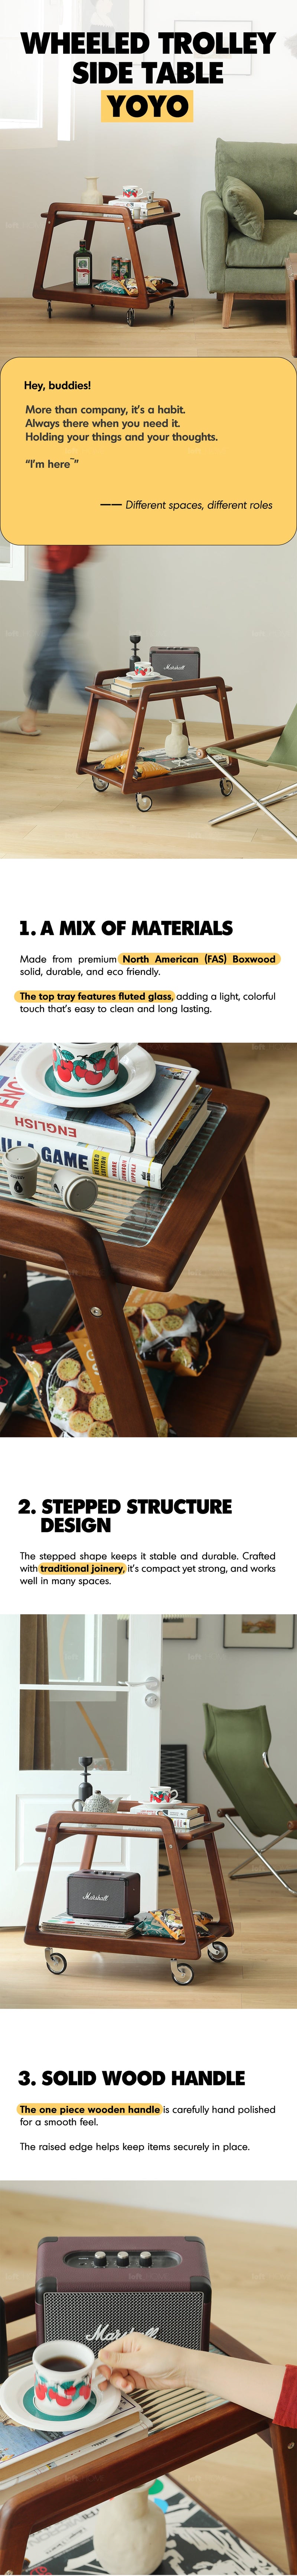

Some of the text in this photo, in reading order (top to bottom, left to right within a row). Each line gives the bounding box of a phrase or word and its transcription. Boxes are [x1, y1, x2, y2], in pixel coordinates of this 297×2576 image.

[9, 1049, 20, 1061] Starkov
[14, 1053, 23, 1062] Dixon
[15, 1116, 76, 1138] ENGLISH
[41, 1146, 89, 1171] GAME
[83, 1892, 109, 1901] Marshall
